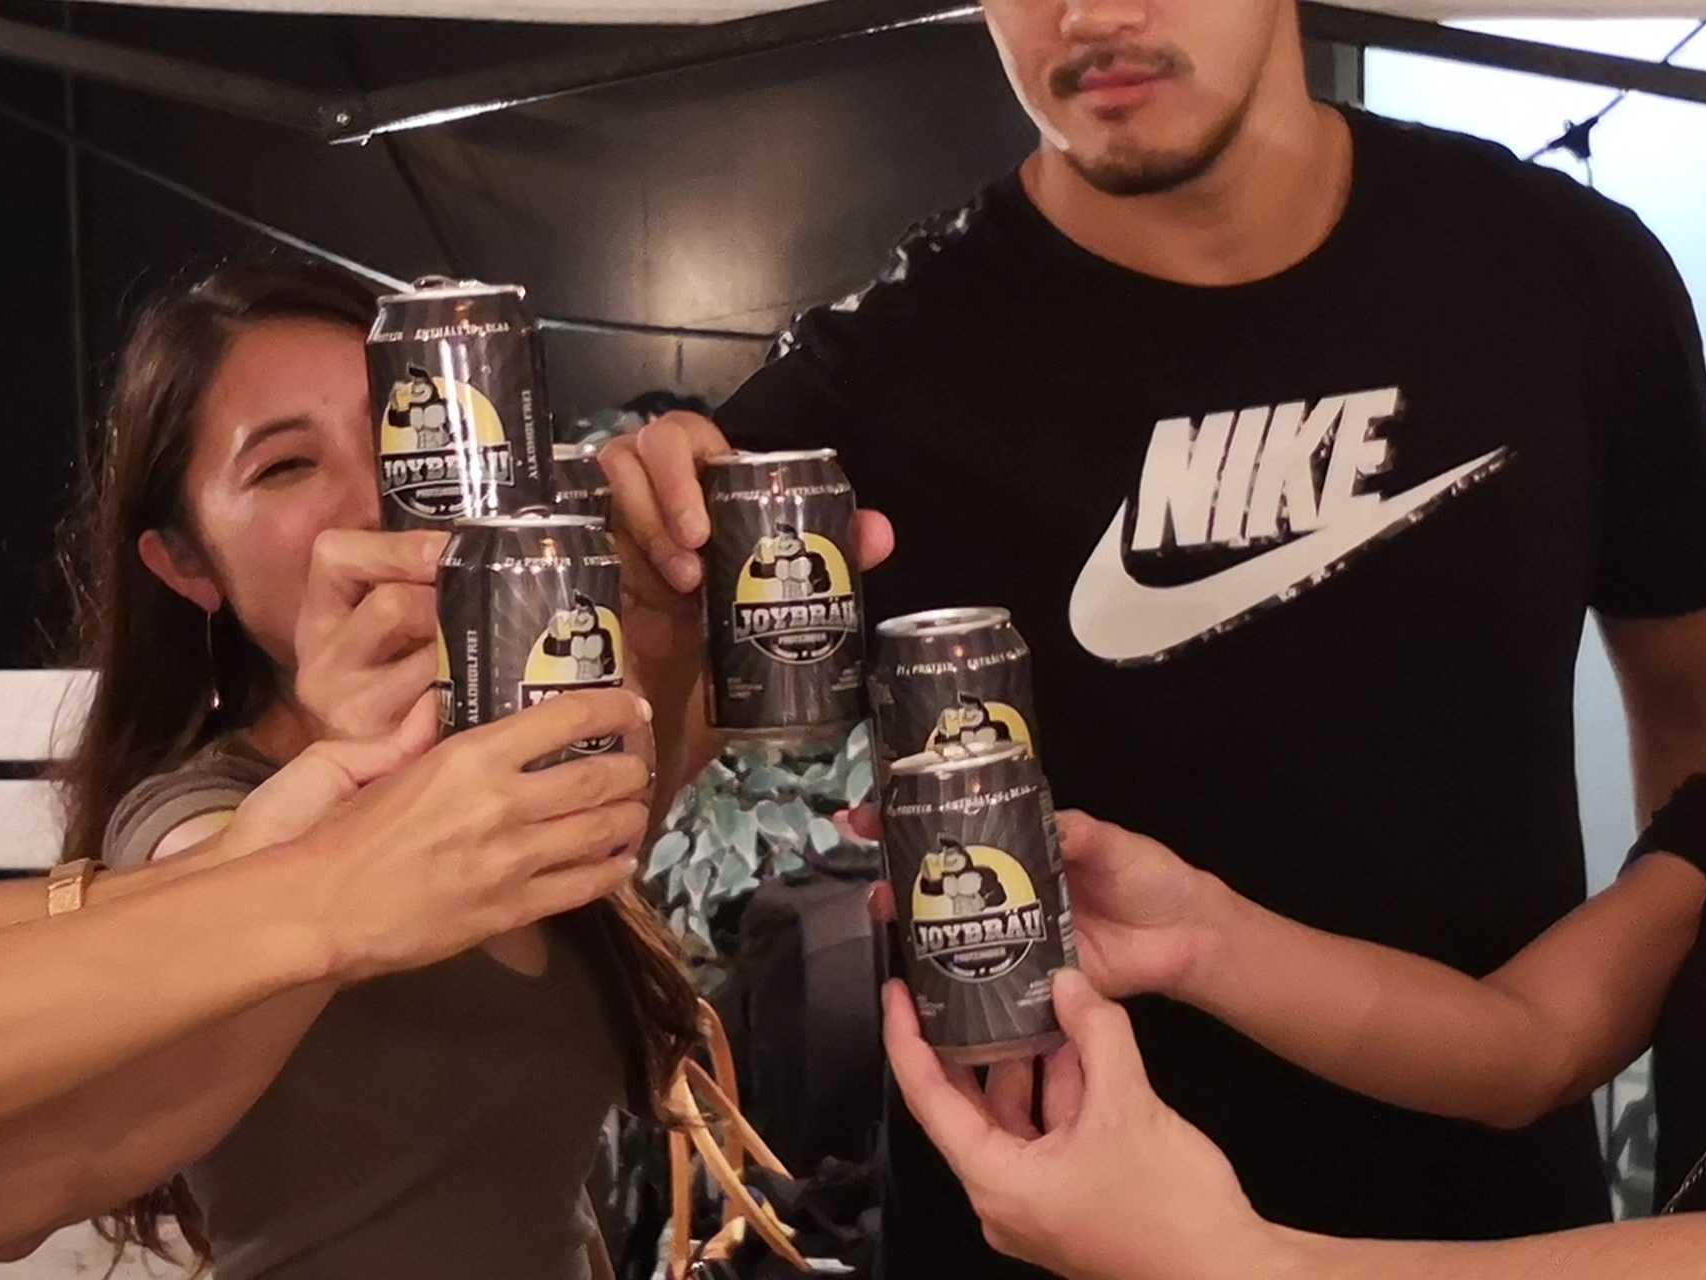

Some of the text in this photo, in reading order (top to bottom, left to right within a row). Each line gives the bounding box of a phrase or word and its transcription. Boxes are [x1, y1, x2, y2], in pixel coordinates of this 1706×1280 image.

[1130, 386, 1399, 552] NIKE
[736, 595, 858, 636] JOYBRÄU
[466, 629, 479, 724] ALKOHOLFREI
[917, 906, 1043, 953] JOYBRÄU
